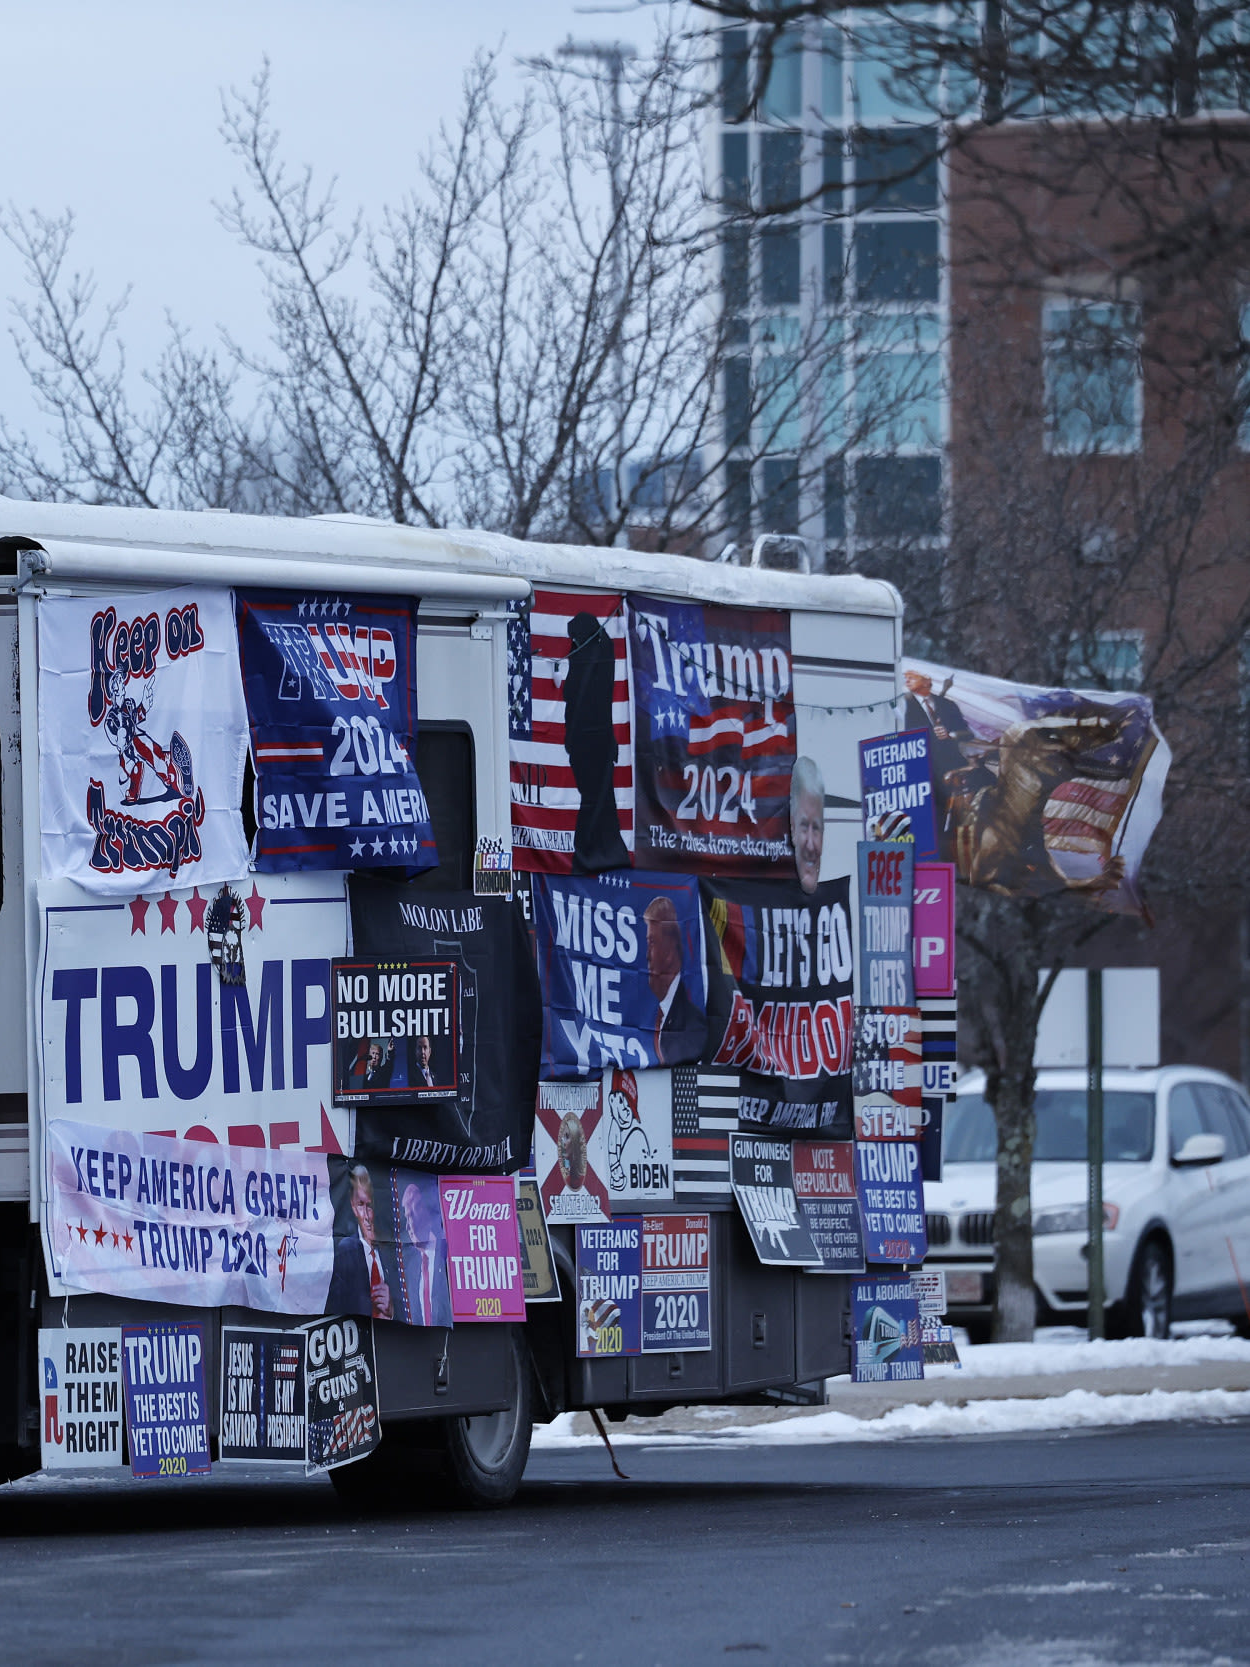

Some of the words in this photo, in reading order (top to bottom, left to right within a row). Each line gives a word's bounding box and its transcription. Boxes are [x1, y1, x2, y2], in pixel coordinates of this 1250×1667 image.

[88, 605, 160, 727] Keep
[166, 603, 204, 660] on
[262, 624, 396, 709] TRUMP
[637, 612, 790, 725] Trump
[863, 739, 926, 769] VETERANS
[881, 764, 907, 786] FOR
[679, 764, 757, 824] 2024
[866, 781, 931, 817] TRUMP
[867, 851, 905, 896] FREE
[398, 902, 450, 933] MOLON
[451, 906, 484, 933] LABE
[552, 889, 639, 964] MISS
[864, 906, 910, 953] TRUMP
[761, 907, 812, 988] LET'S
[816, 902, 851, 986] GO
[337, 975, 369, 1004] NO
[378, 973, 447, 1002] MORE
[571, 960, 623, 1026] ME
[870, 960, 907, 1007] GIFTS
[52, 958, 332, 1104] TRUMP
[337, 1008, 450, 1039] BULLSHIT!
[863, 1014, 910, 1045] STOP
[868, 1060, 905, 1091] THE
[861, 1105, 916, 1137] STEAL
[734, 1141, 753, 1158] GUN
[754, 1142, 790, 1160] OWNERS
[812, 1149, 835, 1169] VOTE
[857, 1142, 919, 1183] TRUMP
[70, 1146, 132, 1200] KEEP
[136, 1157, 236, 1215] AMERICA
[245, 1171, 319, 1221] GREAT!
[630, 1164, 669, 1189] BIDEN
[755, 1165, 773, 1182] FOR
[444, 1189, 510, 1220] Women
[803, 1204, 820, 1215] THEY
[822, 1204, 836, 1214] MAY
[837, 1204, 853, 1214] NOT
[865, 1189, 882, 1209] THE
[883, 1189, 905, 1209] BEST
[907, 1190, 916, 1209] IS
[469, 1225, 497, 1252] FOR
[581, 1229, 638, 1249] VETERANS
[643, 1234, 708, 1267] TRUMP
[451, 1256, 518, 1290] TRUMP
[597, 1252, 619, 1271] FOR
[580, 1275, 639, 1300] TRUMP
[476, 1298, 501, 1316] 2020
[655, 1295, 699, 1329] 2020
[309, 1320, 359, 1366] GOD
[596, 1327, 622, 1353] 2020
[66, 1342, 119, 1374] RAISE
[124, 1334, 202, 1386] TRUMP
[228, 1343, 253, 1376] JESUS
[65, 1382, 119, 1414] THEM
[228, 1378, 237, 1411] IS
[239, 1379, 253, 1411] MY
[275, 1380, 281, 1413] IS
[282, 1380, 295, 1413] MY
[319, 1371, 358, 1404] GUNS
[134, 1395, 158, 1423] THE
[160, 1393, 186, 1420] BEST
[190, 1392, 199, 1418] IS
[338, 1401, 344, 1411] &
[66, 1421, 119, 1454] RIGHT
[131, 1425, 153, 1457] YET
[156, 1427, 171, 1455] TO
[171, 1424, 208, 1453] COME!
[223, 1413, 257, 1447] SAVIOR
[267, 1414, 305, 1448] PRESIDENT
[158, 1457, 187, 1475] 2020
